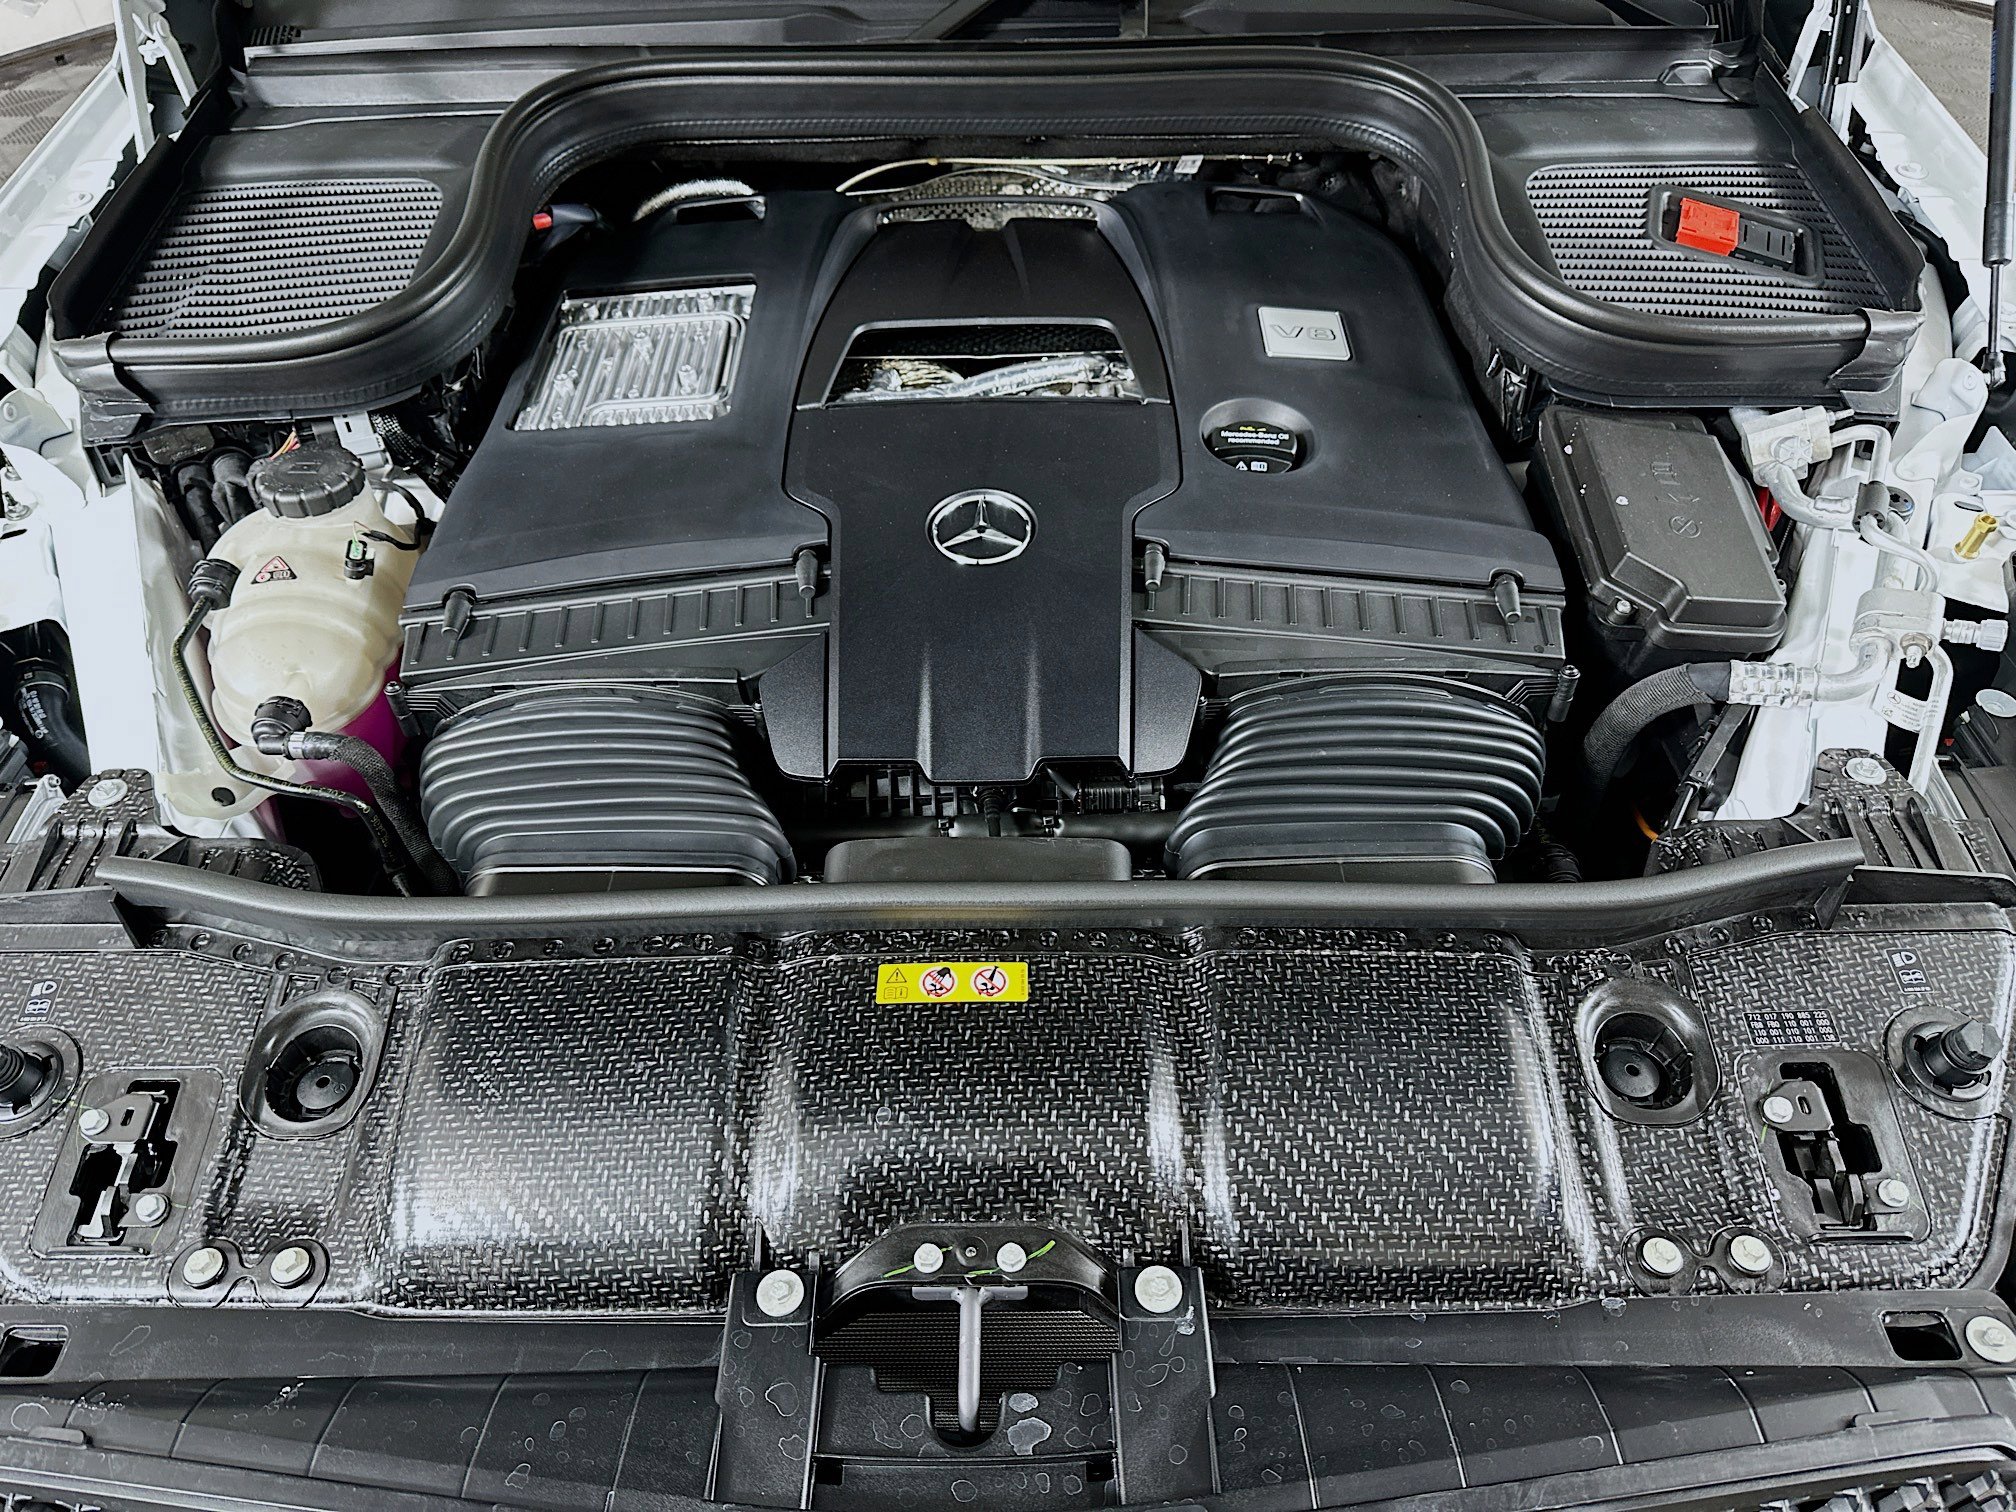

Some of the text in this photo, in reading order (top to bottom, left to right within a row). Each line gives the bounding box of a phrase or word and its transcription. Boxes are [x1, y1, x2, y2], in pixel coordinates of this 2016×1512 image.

[1269, 323, 1337, 341] V8
[1220, 430, 1277, 439] Mercedes-Benz
[1227, 437, 1280, 446] recommended
[1781, 1012, 1794, 1020] 190
[1813, 1011, 1828, 1019] 225
[1799, 1019, 1813, 1027] 001
[1769, 1028, 1783, 1036] 001
[1818, 1026, 1833, 1034] 000
[1789, 1035, 1803, 1043] 110
